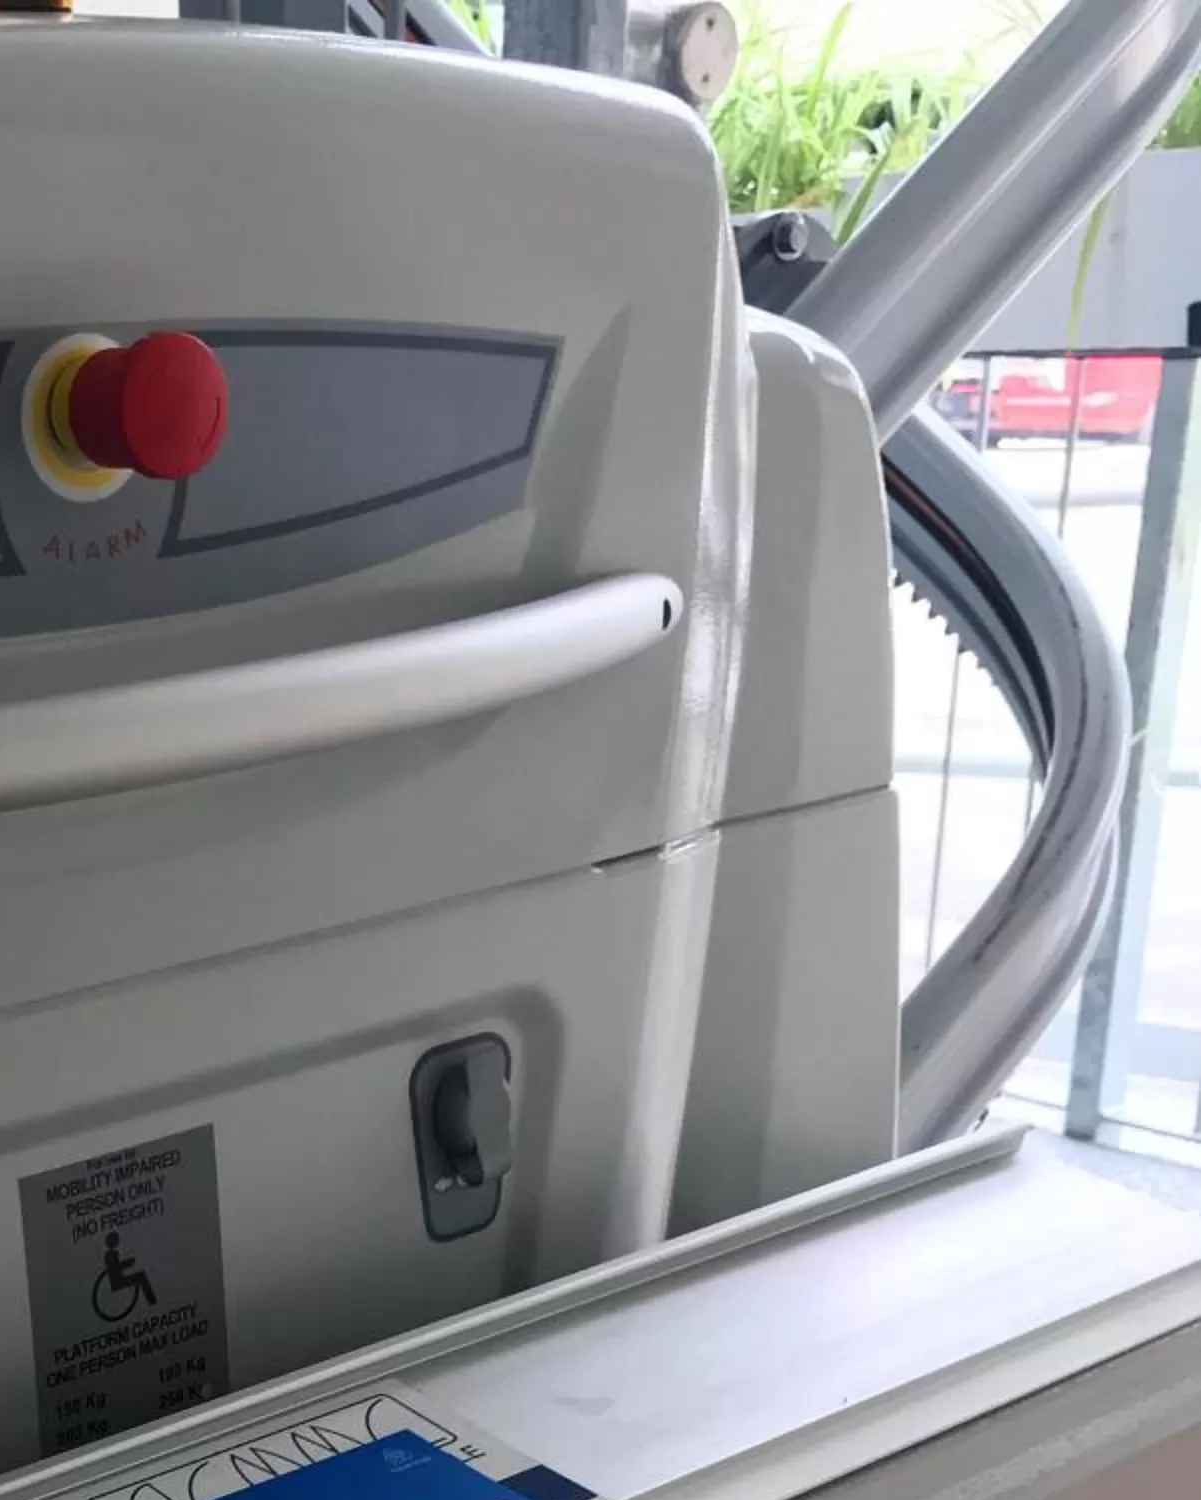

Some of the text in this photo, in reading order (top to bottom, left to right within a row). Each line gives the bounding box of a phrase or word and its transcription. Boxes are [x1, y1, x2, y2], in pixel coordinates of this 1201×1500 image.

[42, 519, 147, 563] ALARM
[46, 1170, 111, 1203] MOBILITY
[115, 1149, 181, 1182] IMPAIRED
[65, 1176, 167, 1221] PERSON ONLY
[71, 1198, 165, 1244] (NO FREIGHT)
[46, 1319, 209, 1389] ONE PERSON MAX LOAD
[54, 1301, 199, 1365] PLATFORM CAPACITY
